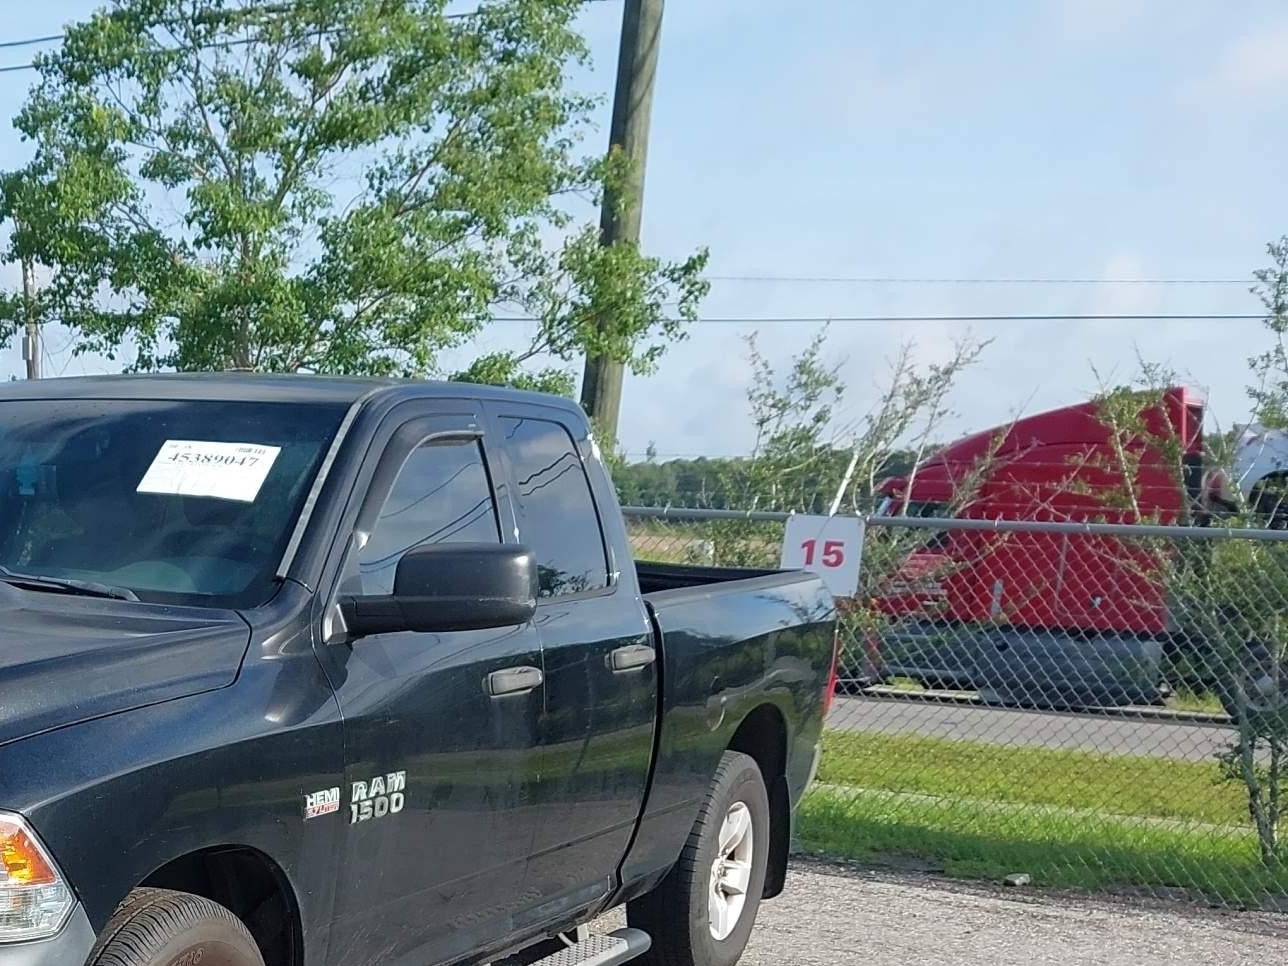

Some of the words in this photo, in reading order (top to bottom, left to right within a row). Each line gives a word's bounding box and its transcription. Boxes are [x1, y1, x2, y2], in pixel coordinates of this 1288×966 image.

[168, 452, 259, 467] 45389047
[801, 539, 845, 568] 15
[304, 786, 340, 809] HEMI
[351, 770, 406, 802] RAM
[349, 792, 405, 825] 1500
